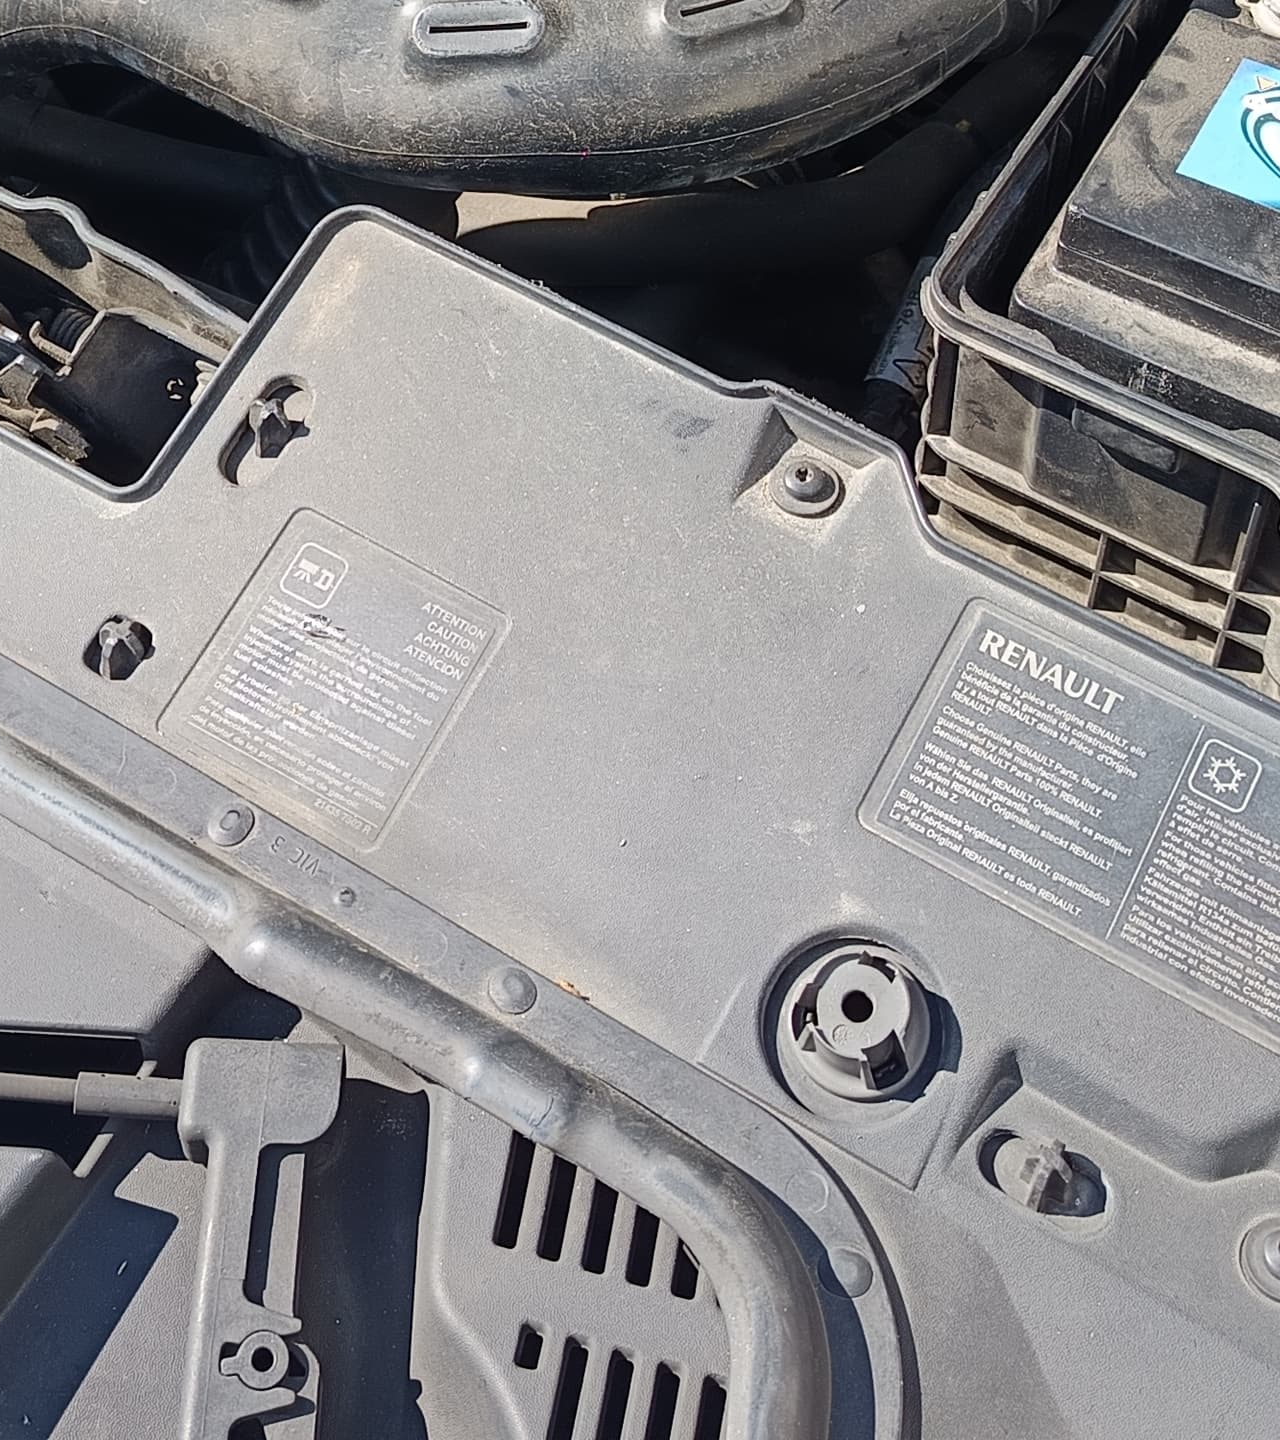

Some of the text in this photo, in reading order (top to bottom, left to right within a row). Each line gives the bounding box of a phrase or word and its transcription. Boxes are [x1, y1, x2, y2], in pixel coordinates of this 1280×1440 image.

[421, 601, 488, 641] ATTENTION
[427, 621, 478, 654] CAUTION
[413, 632, 471, 667] ACHTUNG
[977, 629, 1125, 717] RENAULT
